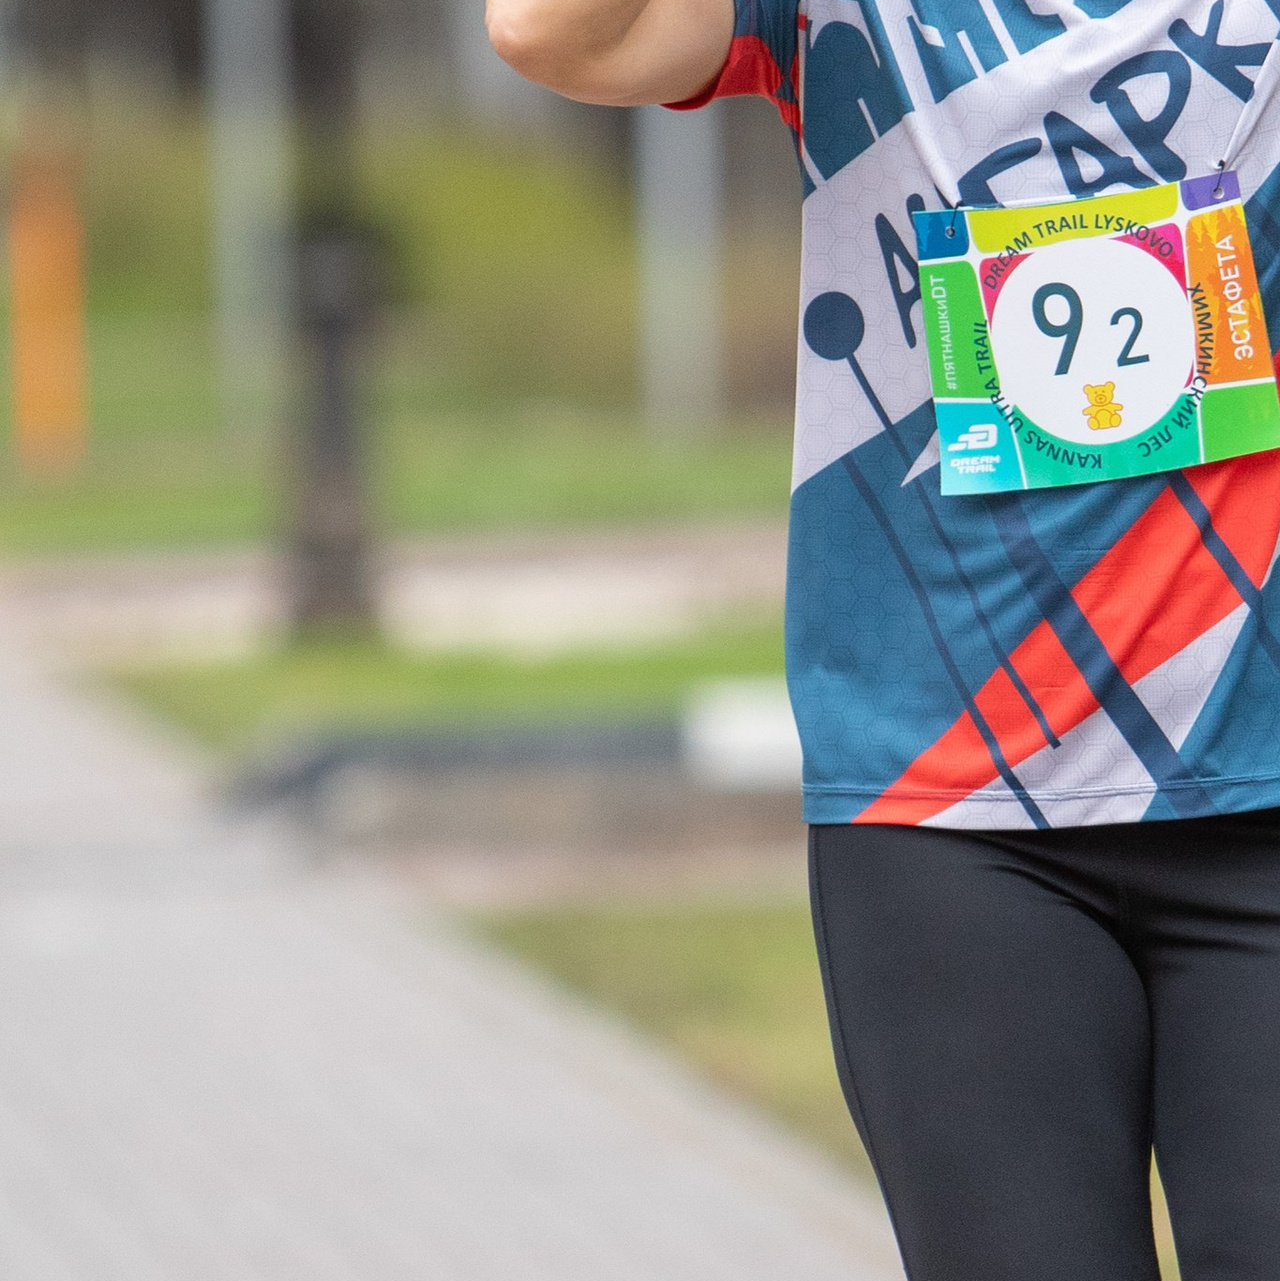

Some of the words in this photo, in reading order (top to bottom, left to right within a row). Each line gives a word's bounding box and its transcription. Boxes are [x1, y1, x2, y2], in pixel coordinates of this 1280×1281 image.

[983, 231, 1033, 290] DREAM
[1032, 214, 1089, 239] TRAIL
[1094, 213, 1174, 258] LYSKOVO
[1215, 234, 1254, 361] ЭСТАФЕТА
[973, 319, 992, 375] TRAIL
[1031, 281, 1084, 376] 9
[1109, 306, 1151, 368] 2
[1171, 282, 1215, 430] ХИМКИНСКИЙ
[950, 455, 1001, 467] DREAM
[956, 464, 997, 475] TRAIL
[1023, 430, 1102, 469] KANNAS
[1136, 425, 1173, 458] ЛЕС
